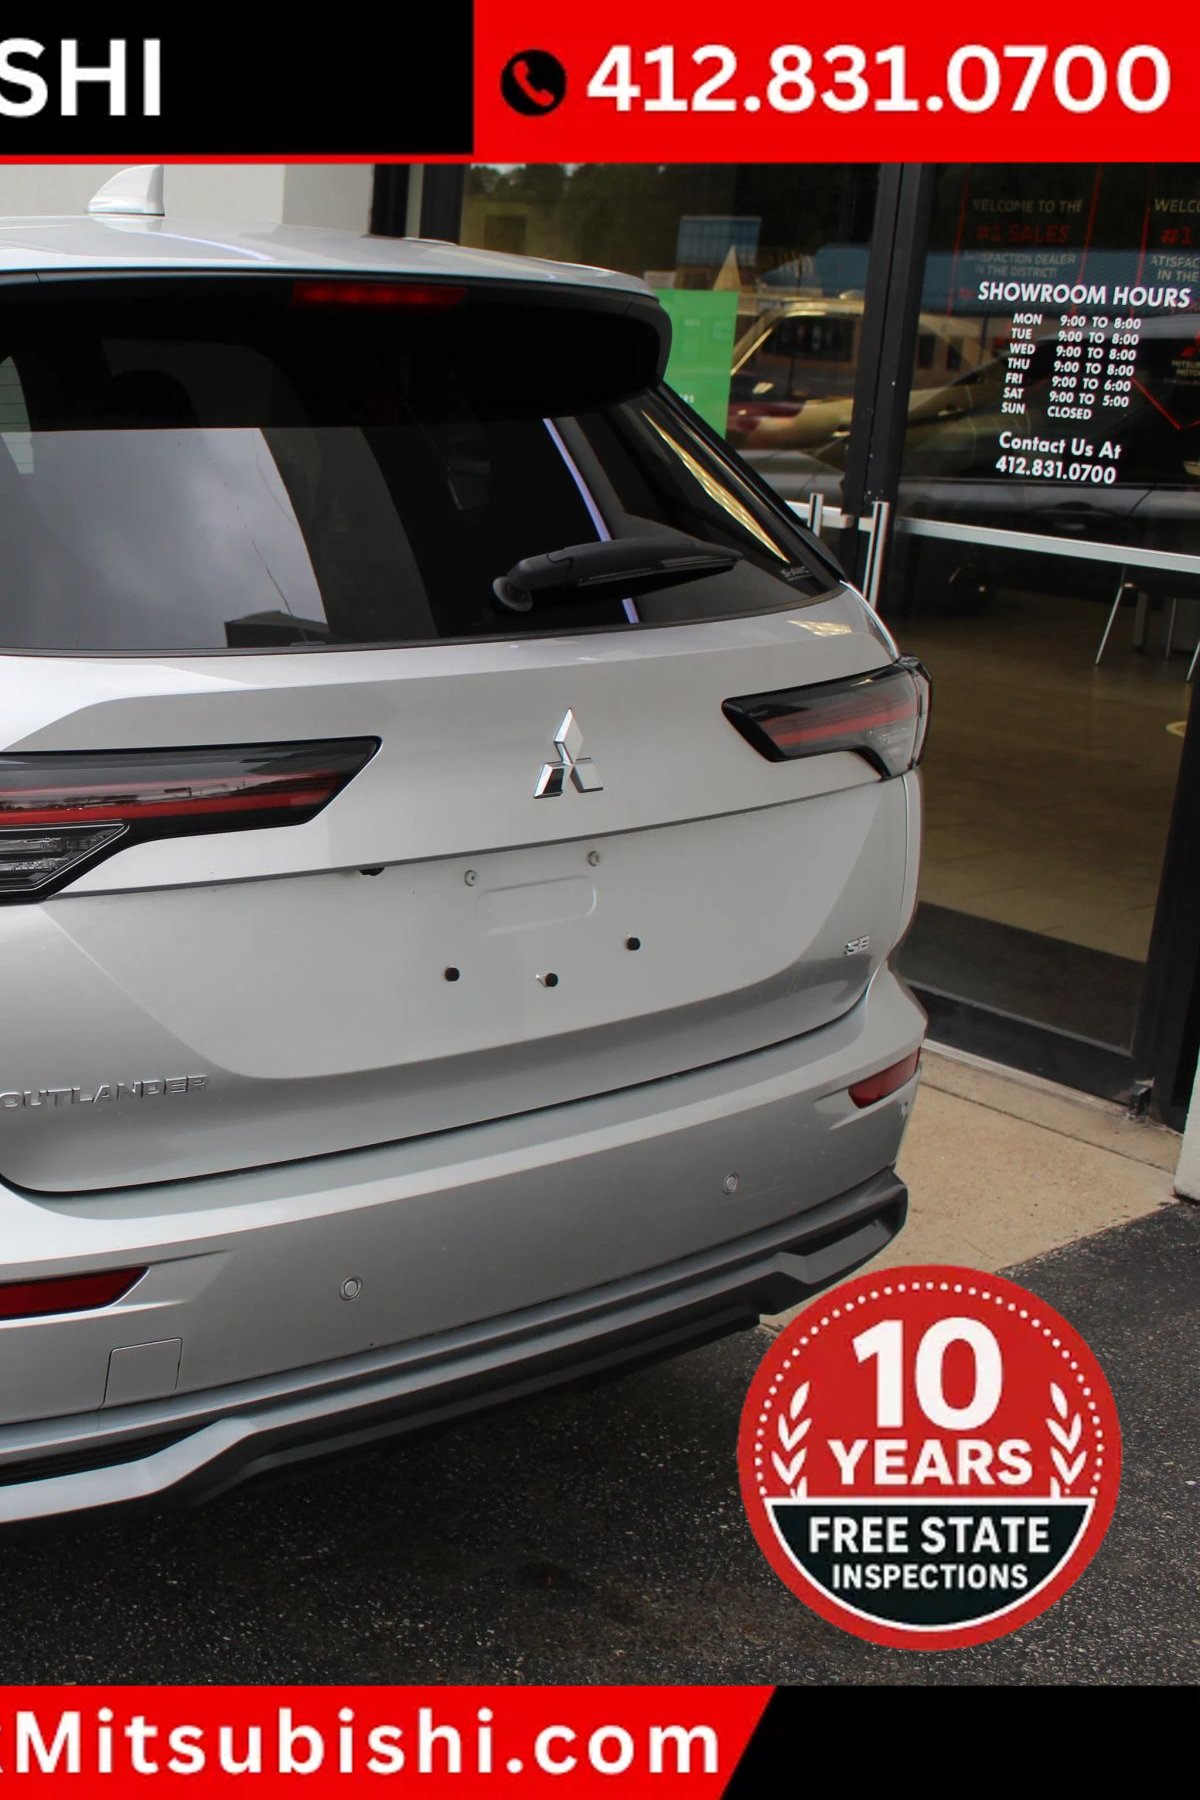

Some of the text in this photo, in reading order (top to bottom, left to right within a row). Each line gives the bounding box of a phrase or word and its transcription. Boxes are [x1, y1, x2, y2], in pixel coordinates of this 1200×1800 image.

[1157, 269, 1172, 281] IN
[978, 281, 1106, 305] SHOWROOM
[1113, 286, 1191, 308] HOURS
[1013, 313, 1141, 330] MON 9:00 TO 8:00
[1011, 328, 1139, 345] TUE 9:00 TO 8:00
[1009, 343, 1136, 361] WED 9:00 TO 8:00
[1007, 358, 1134, 376] THU 9:00 TO 8:00
[1005, 373, 1131, 392] FRI 9:00 TO 6:00
[1003, 387, 1129, 407] SAT 9:00 TO 5:00
[1001, 402, 1092, 420] SUN CLOSED
[999, 431, 1121, 460] Contact Us At
[996, 456, 1116, 484] 412.831.0700
[844, 935, 870, 956] SE
